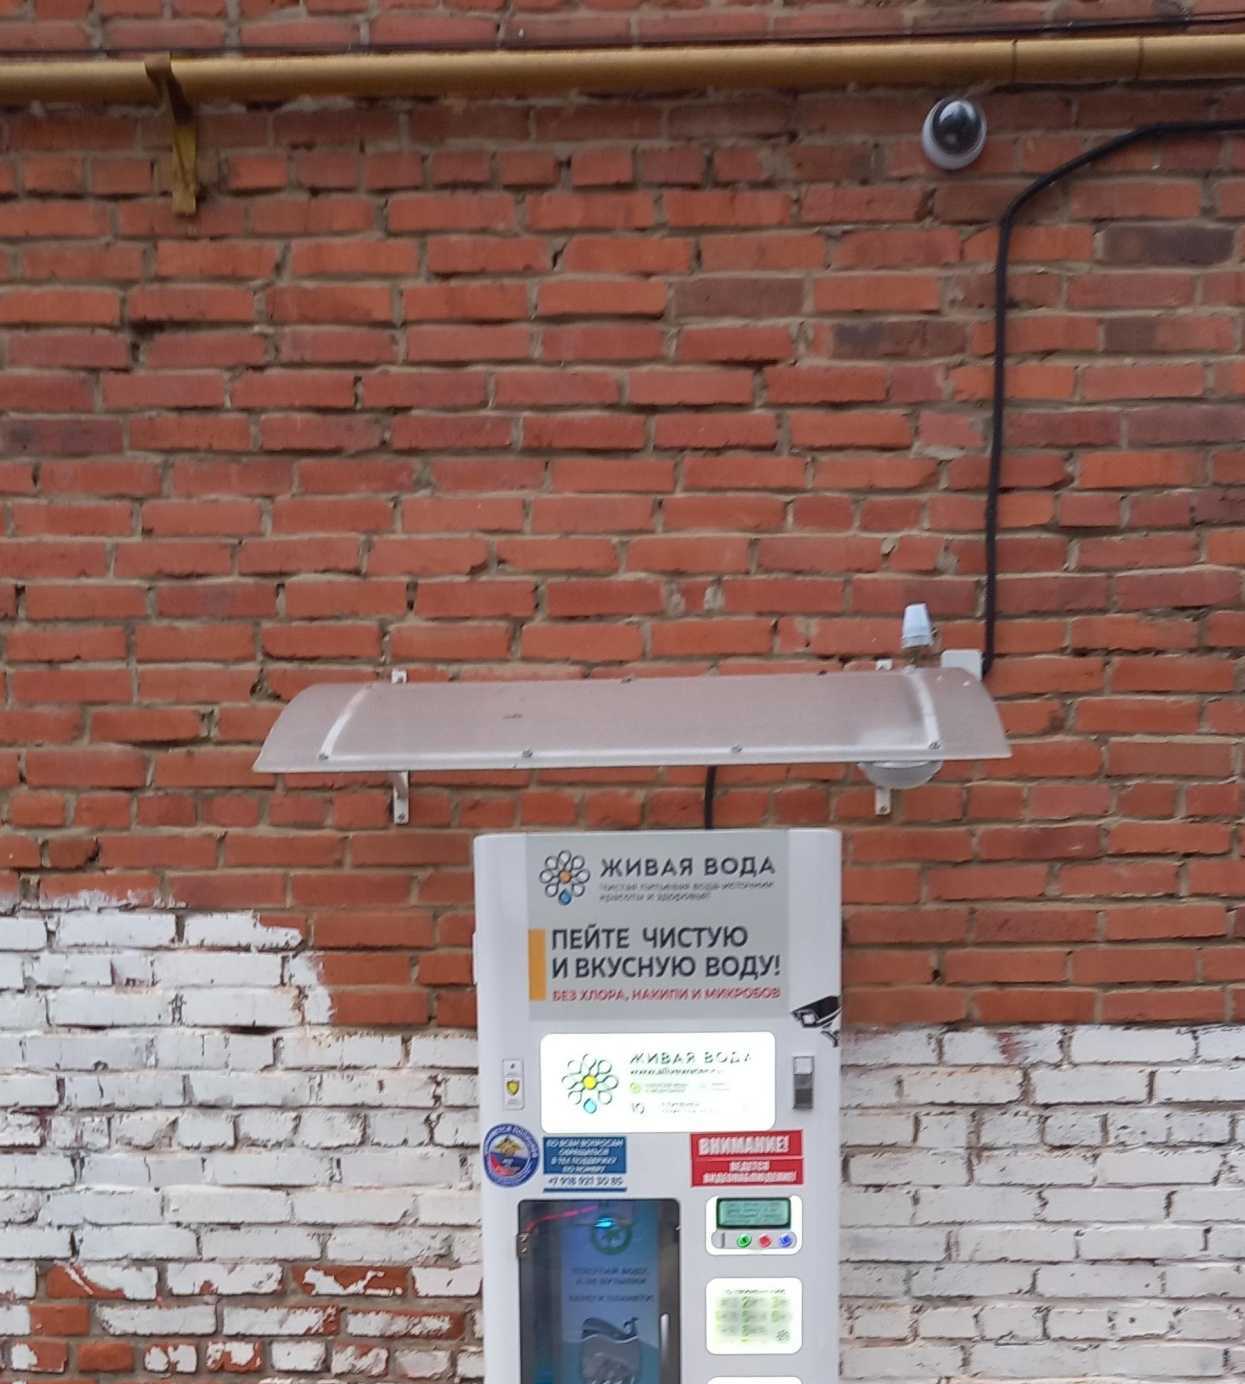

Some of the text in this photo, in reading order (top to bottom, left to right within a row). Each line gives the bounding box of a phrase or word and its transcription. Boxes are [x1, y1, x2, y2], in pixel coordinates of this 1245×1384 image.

[601, 856, 776, 878] ЖИВАЯ ВОДА
[552, 925, 748, 950] ПЕЙТЕ ЧИСТУЮ
[552, 954, 781, 980] И ВКУСНУЮ ВОДУ!
[552, 986, 781, 1001] БЕЗ ХЛОРА, НАКИПИ И МИКРОБОВ
[699, 1135, 789, 1155] ВНИМАНИЕ!
